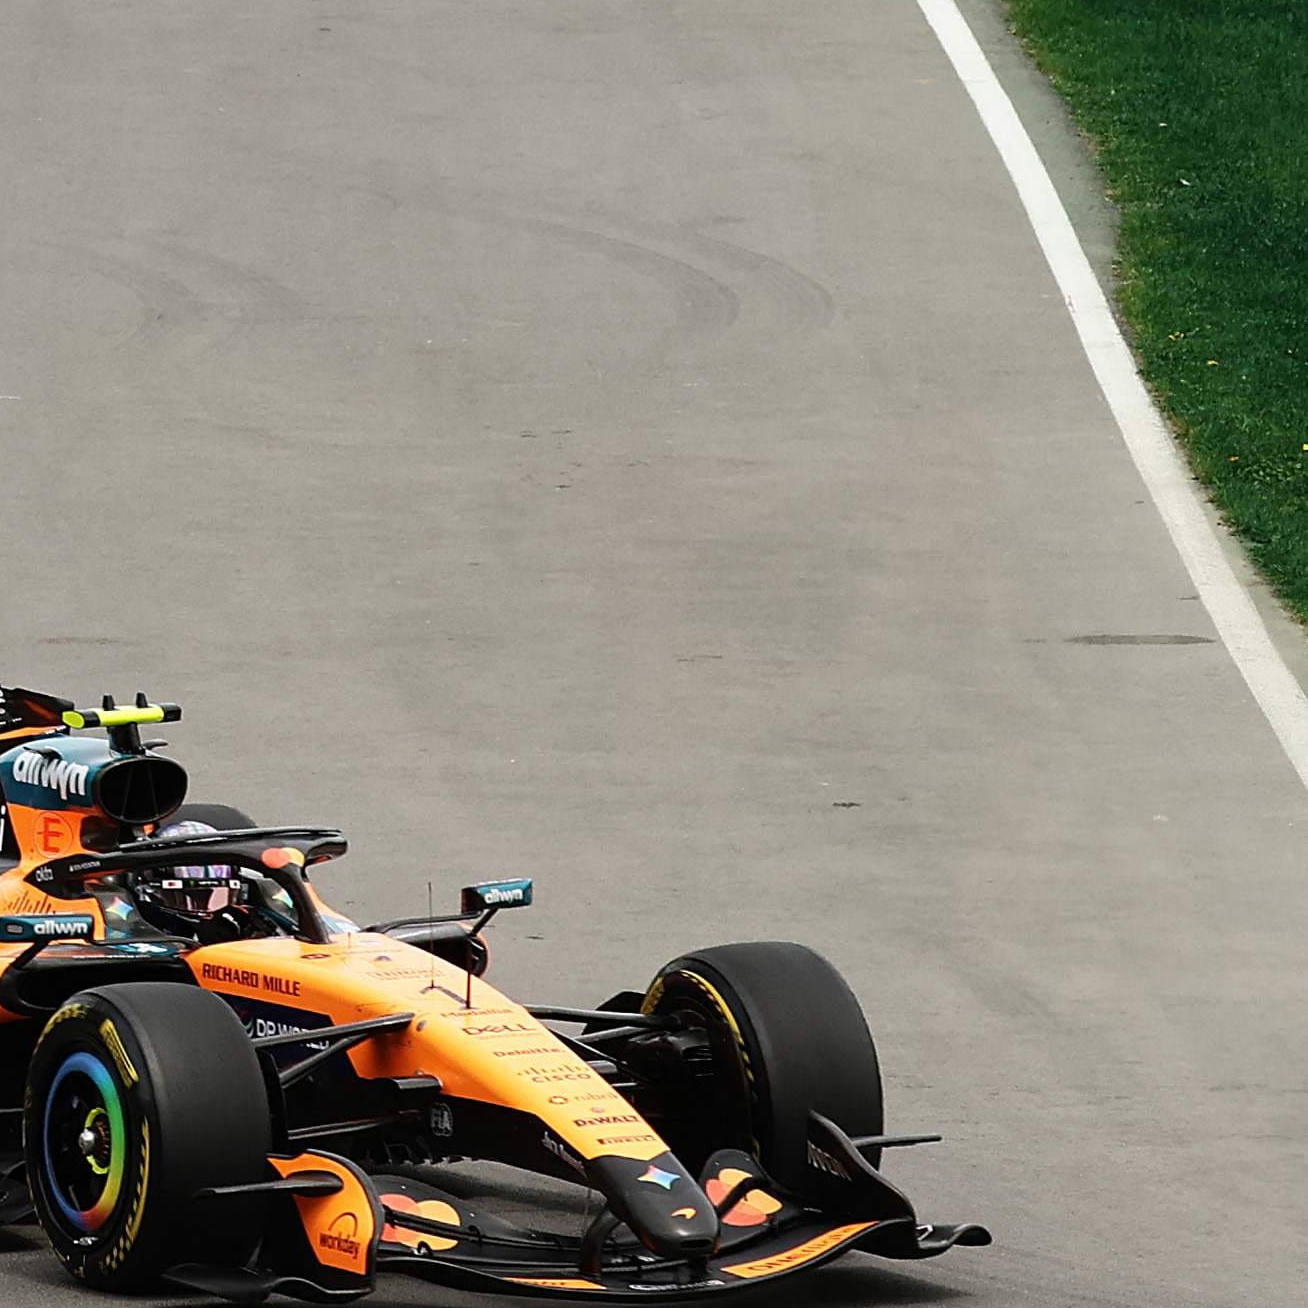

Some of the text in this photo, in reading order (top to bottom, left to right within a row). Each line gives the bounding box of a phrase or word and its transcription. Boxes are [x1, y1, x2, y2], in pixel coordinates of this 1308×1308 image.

[13, 752, 90, 800] allwyn
[484, 888, 524, 904] allwyn
[34, 919, 88, 936] allwyn
[201, 962, 301, 997] RICHARD MILLE
[462, 1023, 537, 1036] DELL
